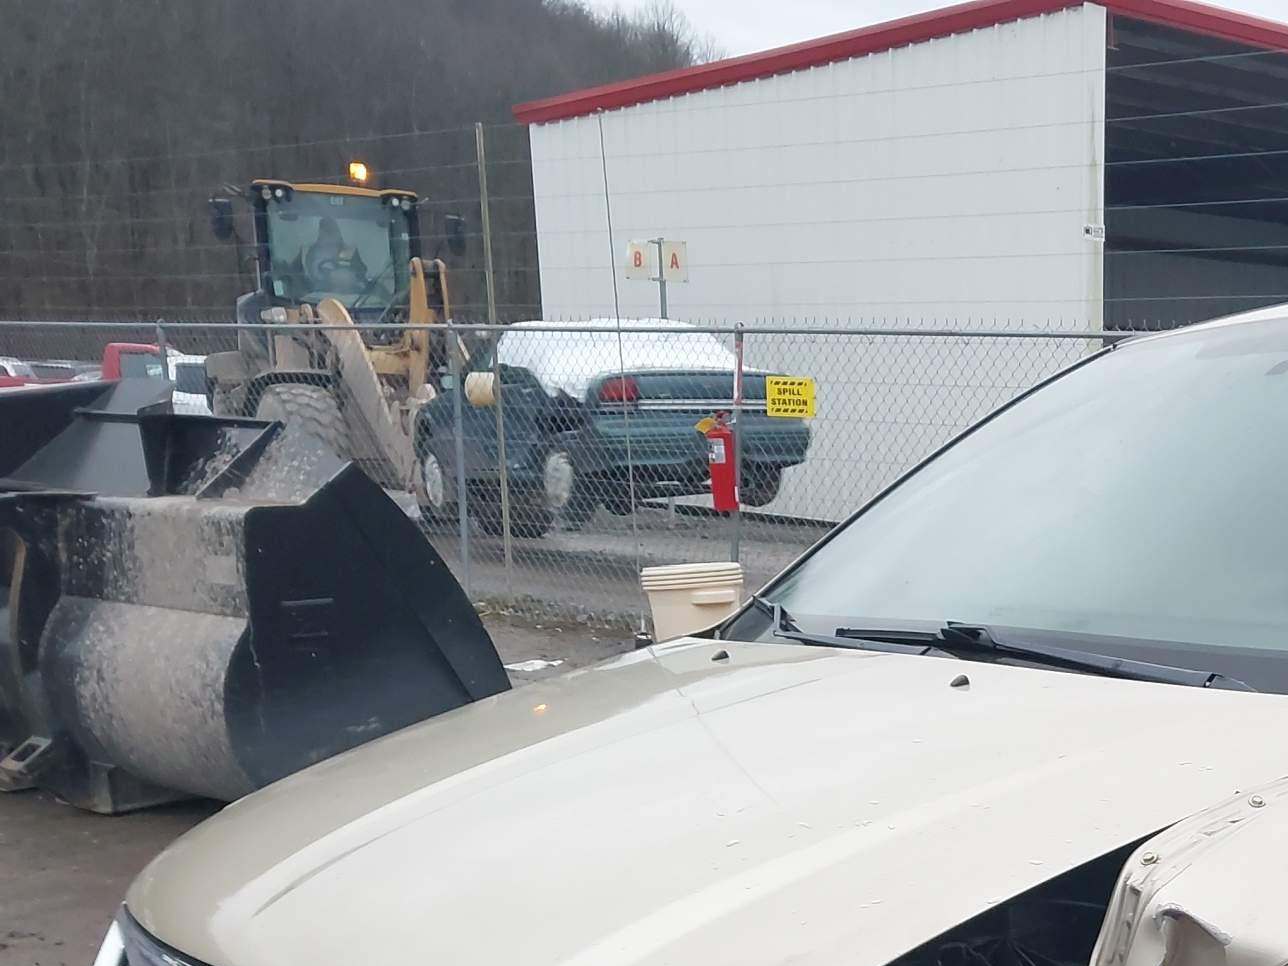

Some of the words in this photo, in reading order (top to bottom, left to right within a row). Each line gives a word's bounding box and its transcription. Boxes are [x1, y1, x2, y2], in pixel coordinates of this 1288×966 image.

[633, 251, 642, 267] B
[670, 253, 680, 270] A
[777, 388, 802, 396] SPILL
[771, 398, 808, 407] STATION
